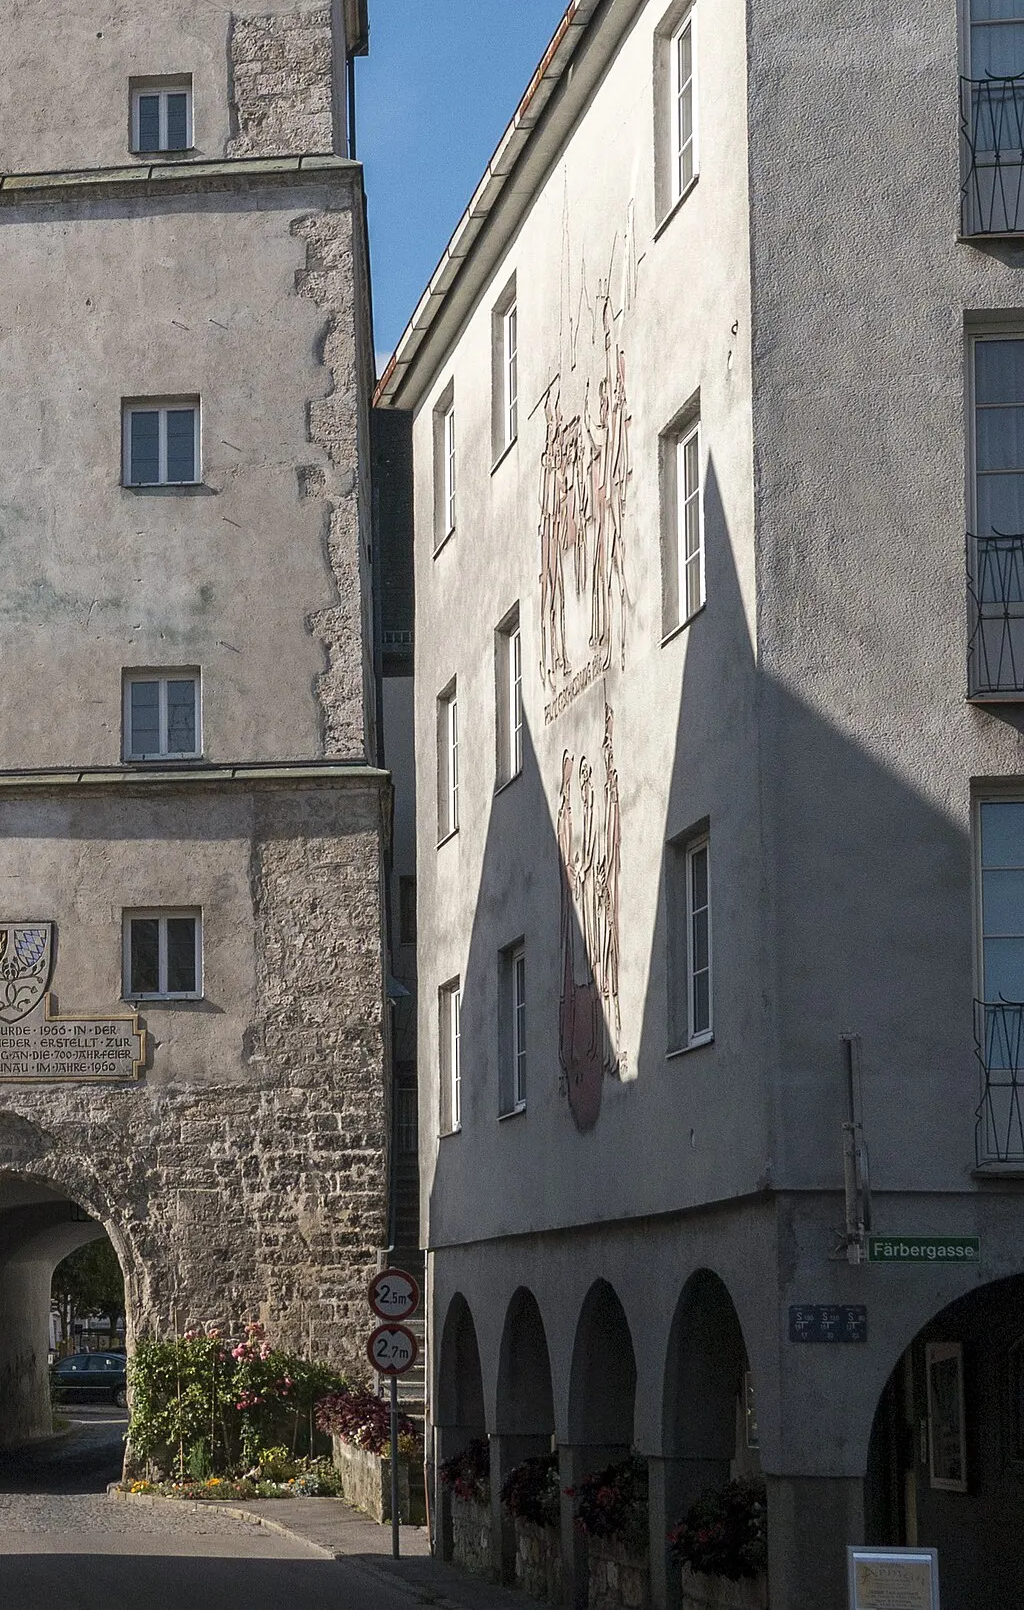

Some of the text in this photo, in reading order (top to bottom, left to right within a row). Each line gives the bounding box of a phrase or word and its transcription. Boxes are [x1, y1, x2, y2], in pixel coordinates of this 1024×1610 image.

[40, 1026, 66, 1035] 1966
[74, 1026, 86, 1035] IN
[95, 1026, 117, 1035] DER
[41, 1038, 98, 1047] ERSTELLT
[106, 1038, 132, 1047] ZUR
[12, 1051, 28, 1060] AN
[33, 1051, 50, 1059] DIE
[37, 1063, 50, 1072] IM
[55, 1062, 86, 1072] JAHRE
[91, 1061, 116, 1073] 1960
[873, 1241, 975, 1260] Färbergasse
[379, 1285, 406, 1304] 2,5m
[377, 1339, 408, 1358] 2,7m
